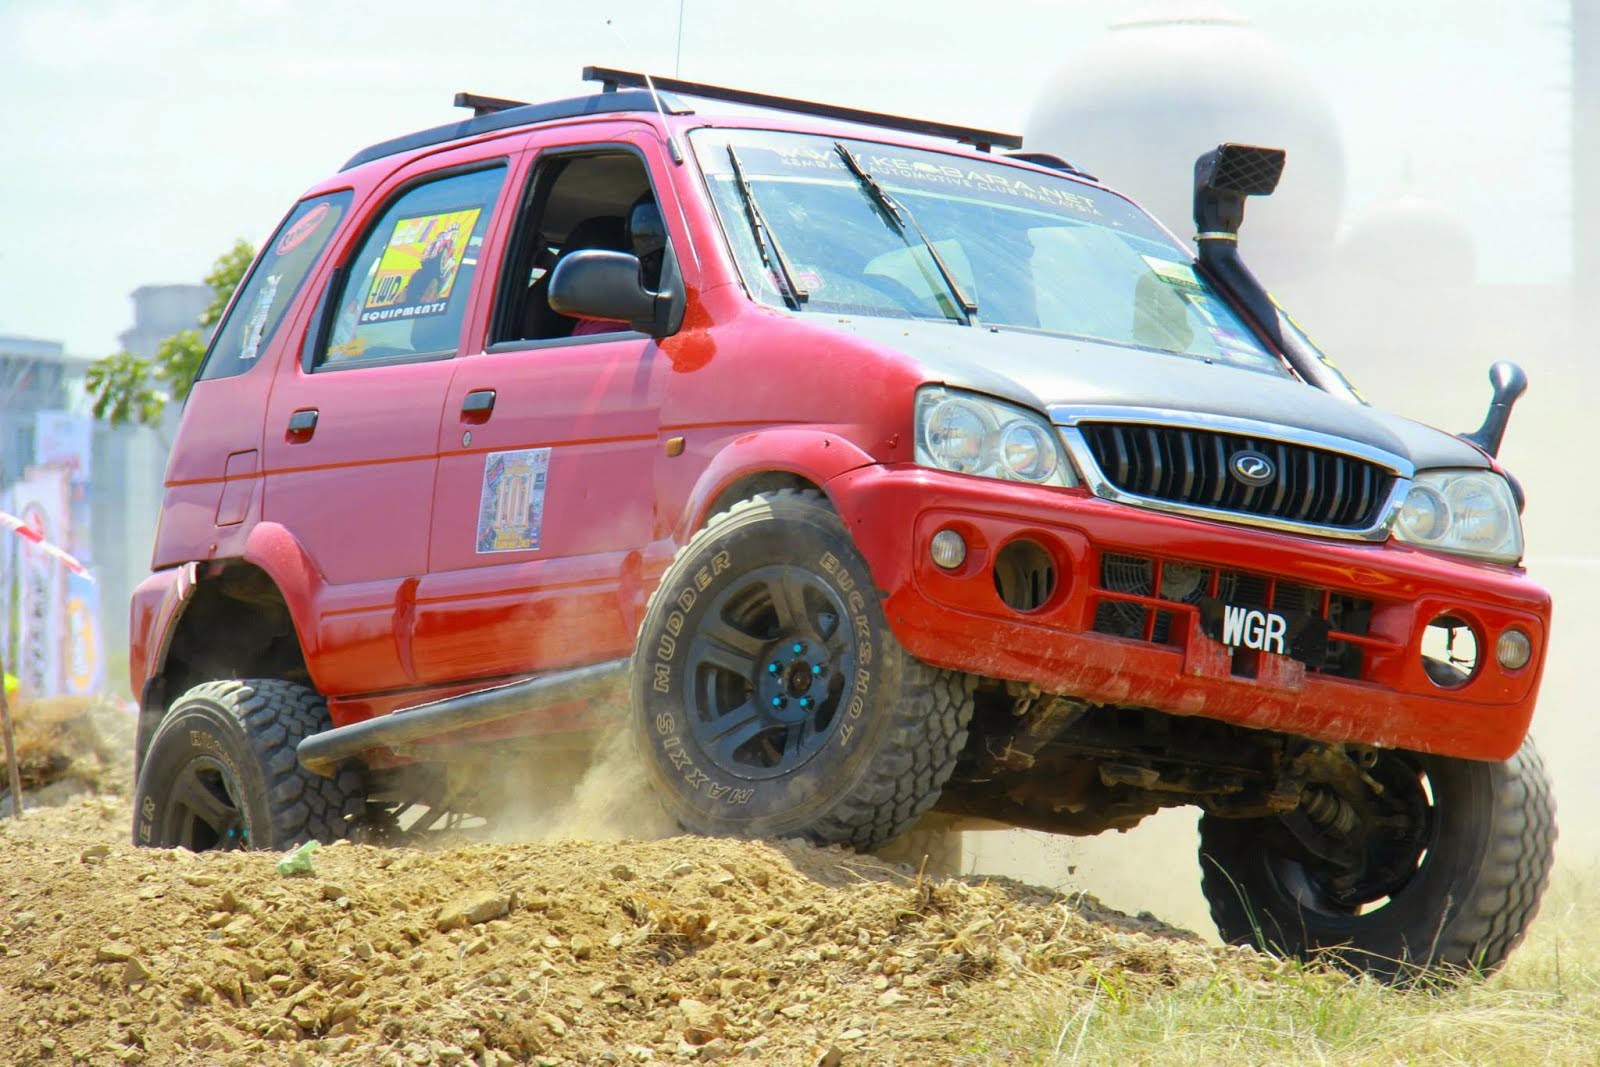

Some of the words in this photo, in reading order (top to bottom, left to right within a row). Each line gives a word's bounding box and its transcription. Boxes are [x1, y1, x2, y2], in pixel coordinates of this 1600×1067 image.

[780, 157, 850, 173] KEMBAR
[869, 165, 973, 188] AUTOMOTIVE
[977, 182, 1018, 196] CLUB
[361, 302, 447, 321] EQUIPMENTS
[654, 551, 732, 692] MUDDER
[819, 552, 873, 746] BUCKSHOT
[1223, 605, 1287, 655] WGR
[656, 712, 755, 804] MAXXIS
